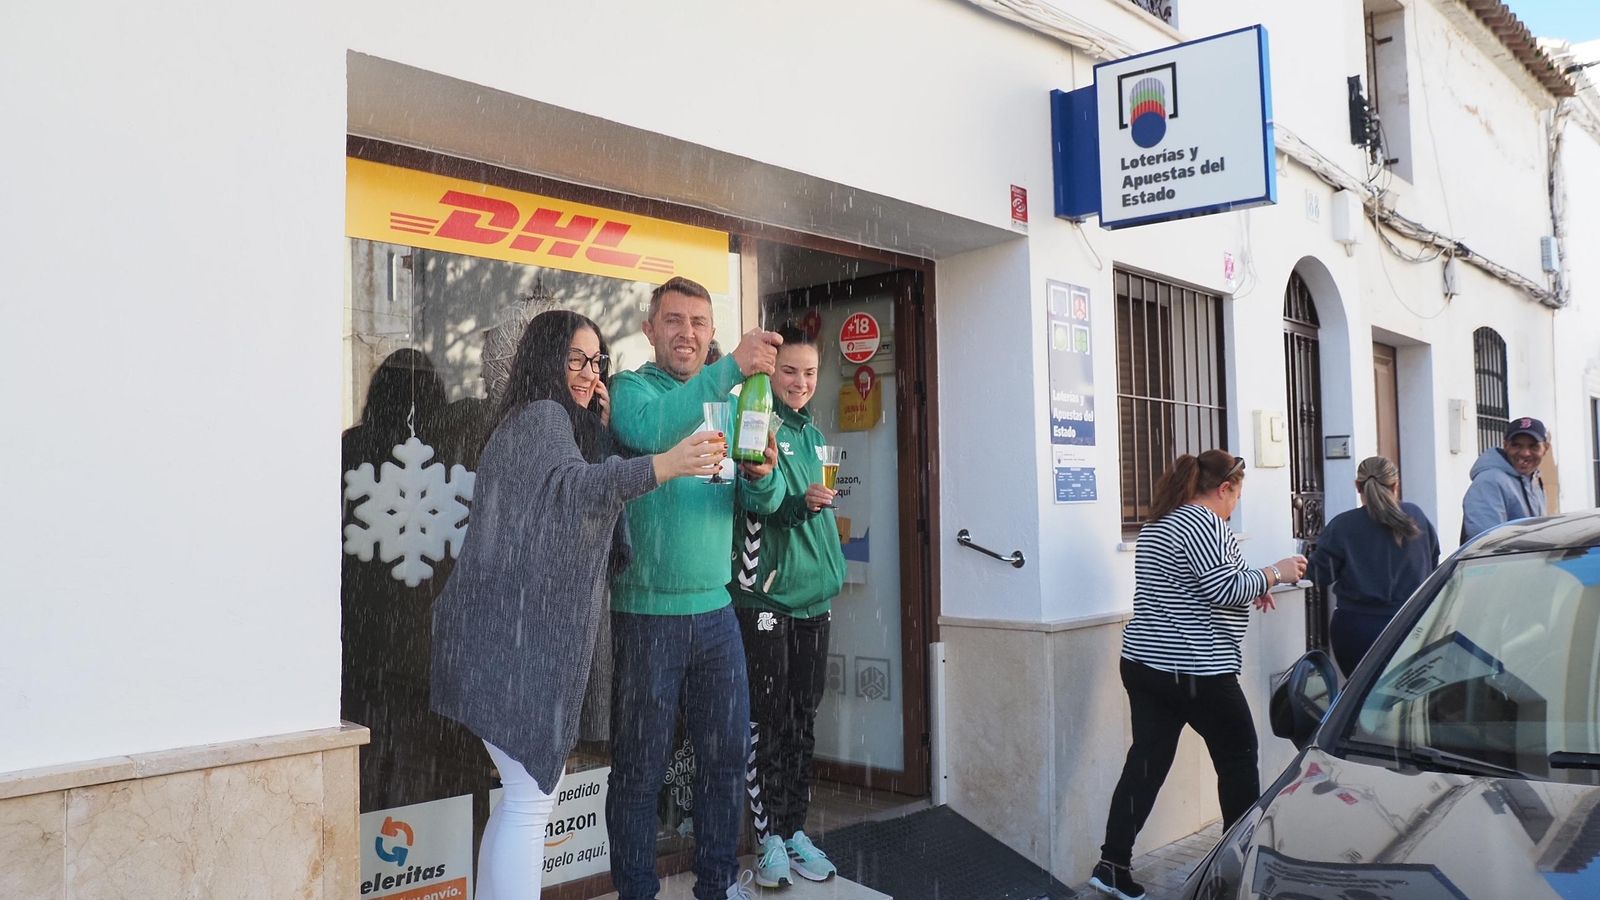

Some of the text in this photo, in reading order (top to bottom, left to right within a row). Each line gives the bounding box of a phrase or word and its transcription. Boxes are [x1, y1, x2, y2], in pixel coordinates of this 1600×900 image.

[1120, 146, 1198, 171] Loterías y
[1122, 157, 1225, 190] Apuestas del
[1122, 186, 1176, 208] Estado
[434, 190, 642, 268] DHL
[848, 317, 870, 335] +18
[1053, 425, 1076, 438] Estado
[558, 782, 600, 806] pedido
[577, 841, 607, 862] aquí.
[360, 863, 446, 895] eleritas
